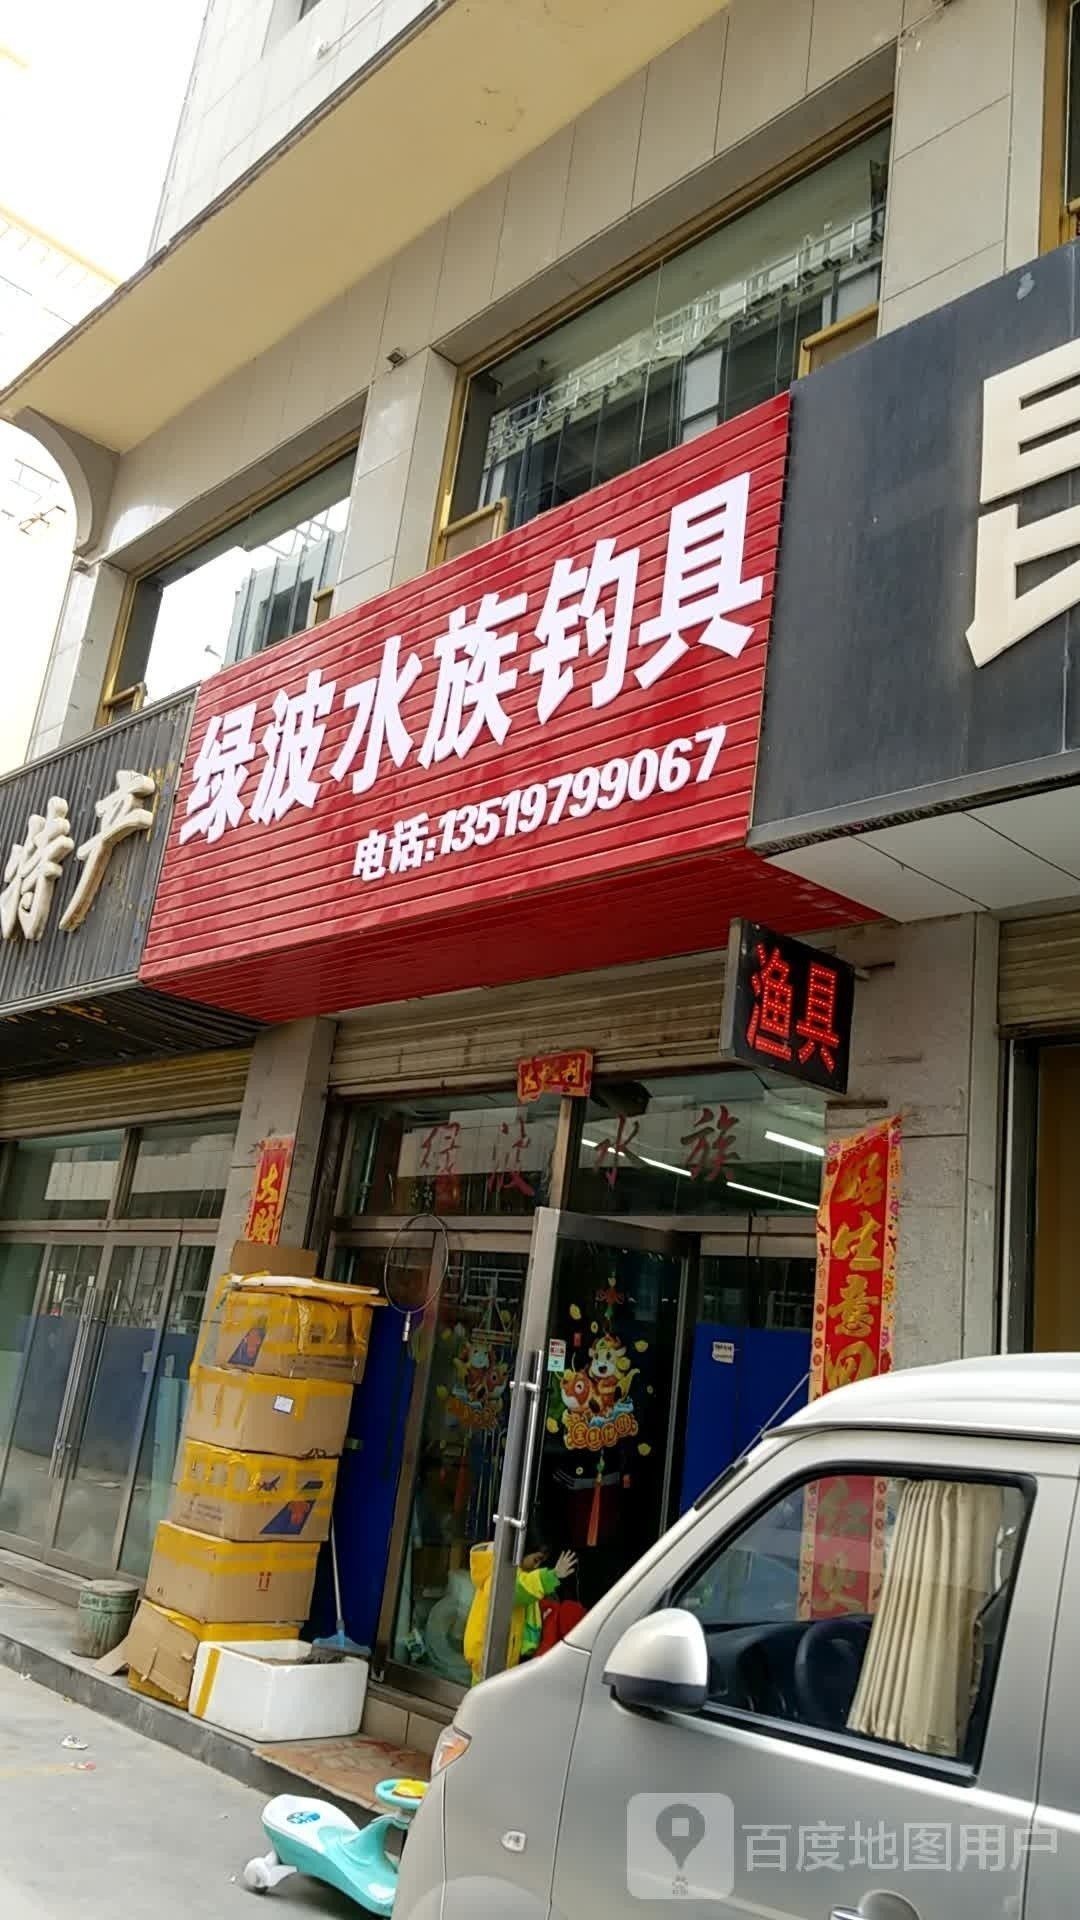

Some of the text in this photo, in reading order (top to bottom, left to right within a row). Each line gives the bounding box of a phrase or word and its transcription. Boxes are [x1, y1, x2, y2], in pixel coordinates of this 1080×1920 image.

[178, 472, 763, 845] 绿波水族钓具
[0, 769, 155, 941] 特产
[747, 944, 839, 1072] 渔具
